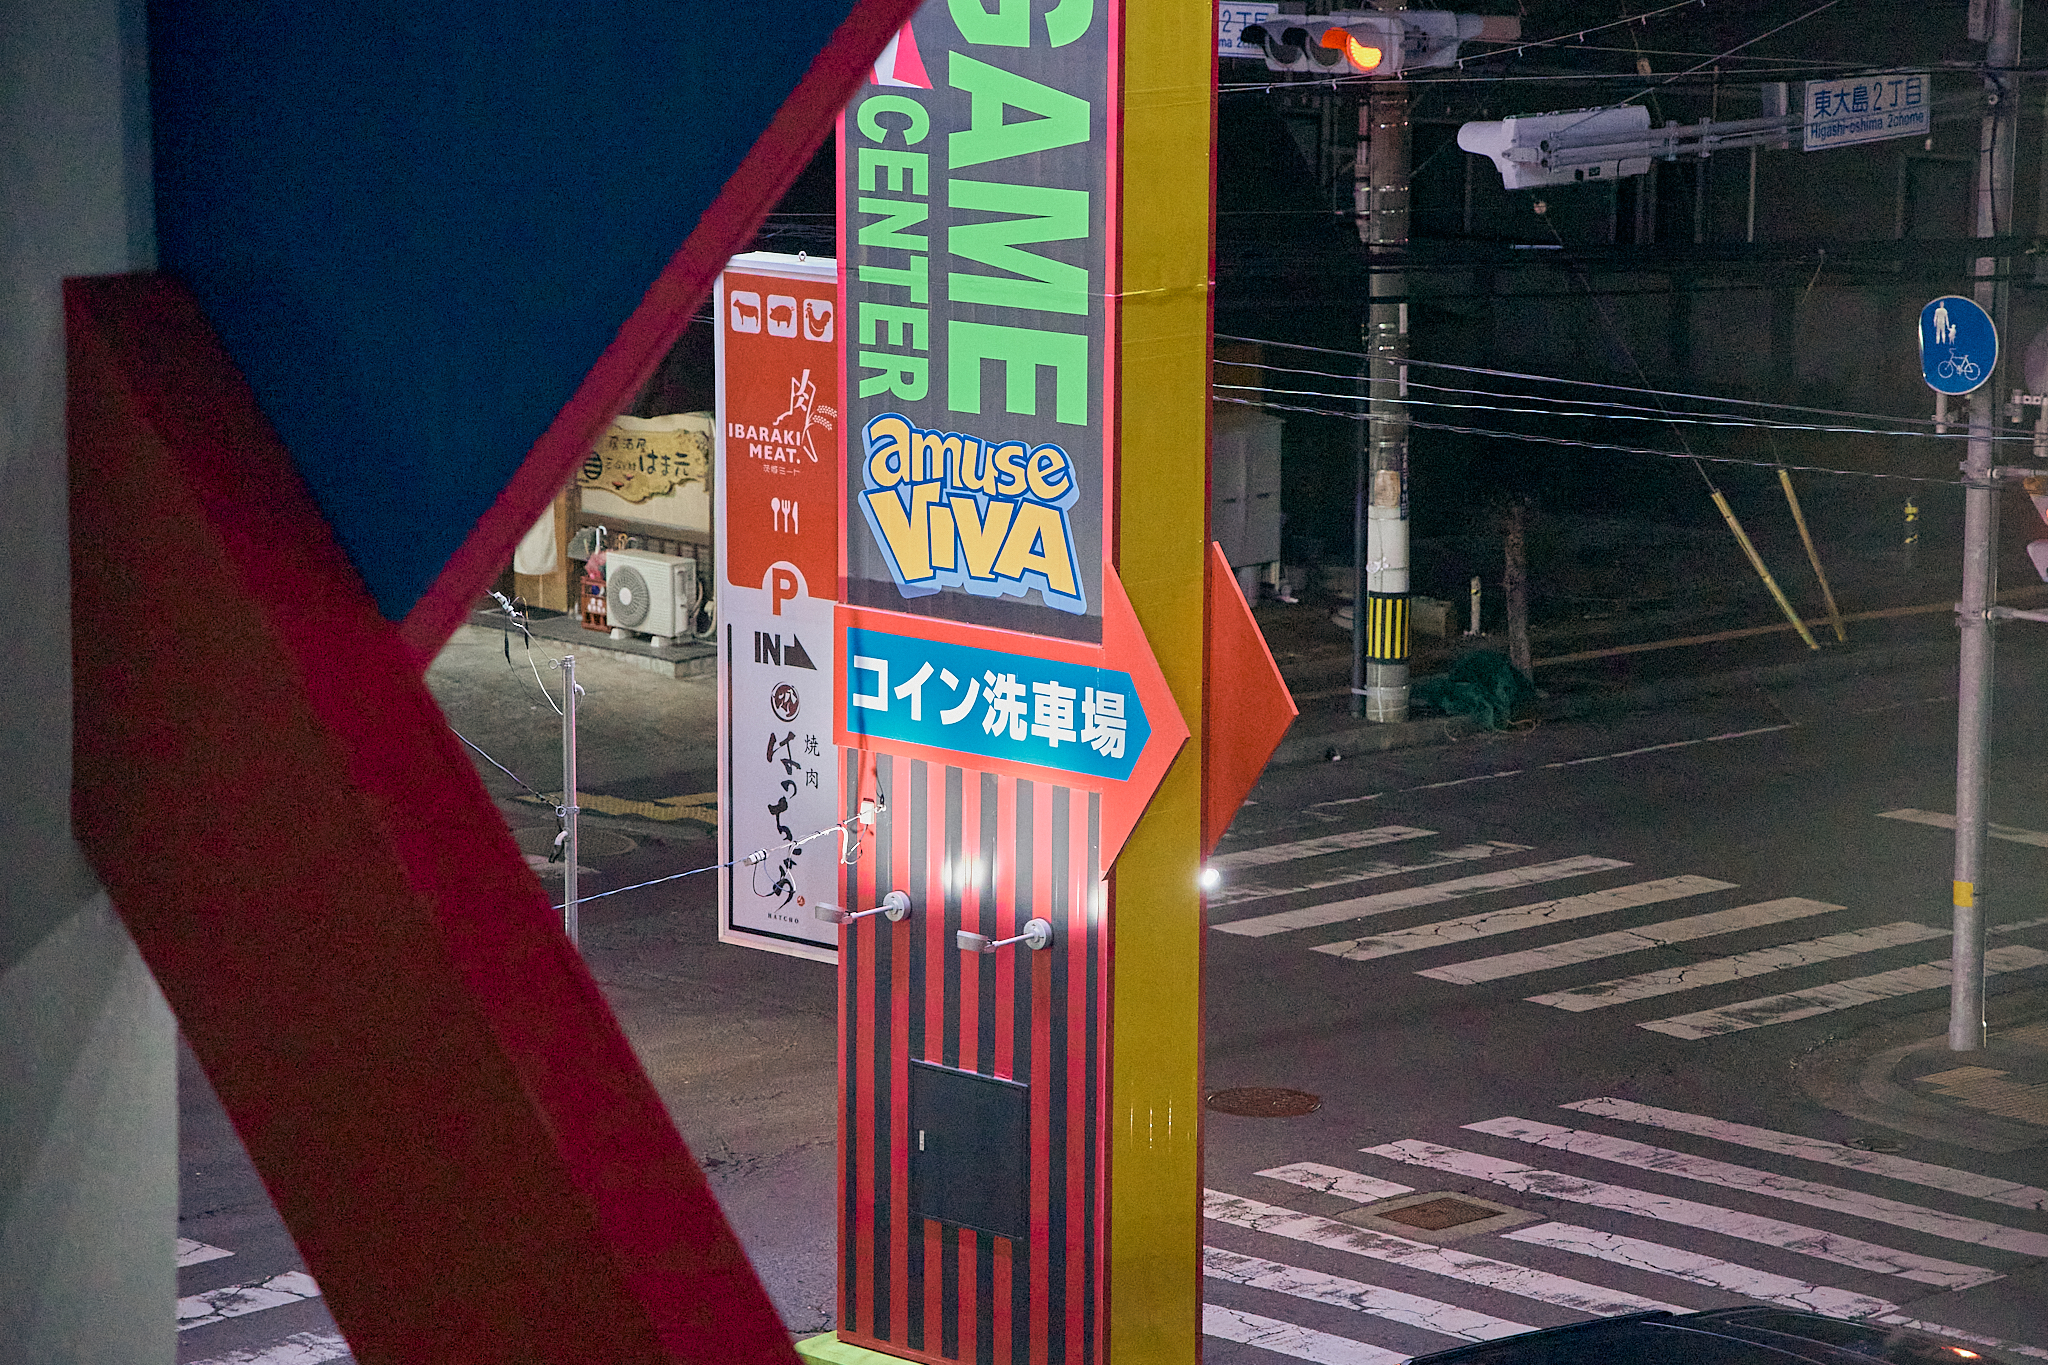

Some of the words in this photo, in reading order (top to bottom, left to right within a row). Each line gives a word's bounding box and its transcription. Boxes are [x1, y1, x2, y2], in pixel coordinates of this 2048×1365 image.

[1813, 77, 1921, 119] 東大島2丁目
[857, 95, 930, 401] CENTER
[728, 422, 801, 446] IBARAKI
[749, 443, 801, 464] MEAT.
[868, 413, 1074, 503] amuse
[772, 567, 799, 616] P
[754, 630, 781, 667] IN
[853, 655, 1127, 759] コイン洗車場
[804, 734, 821, 790] 焼肉
